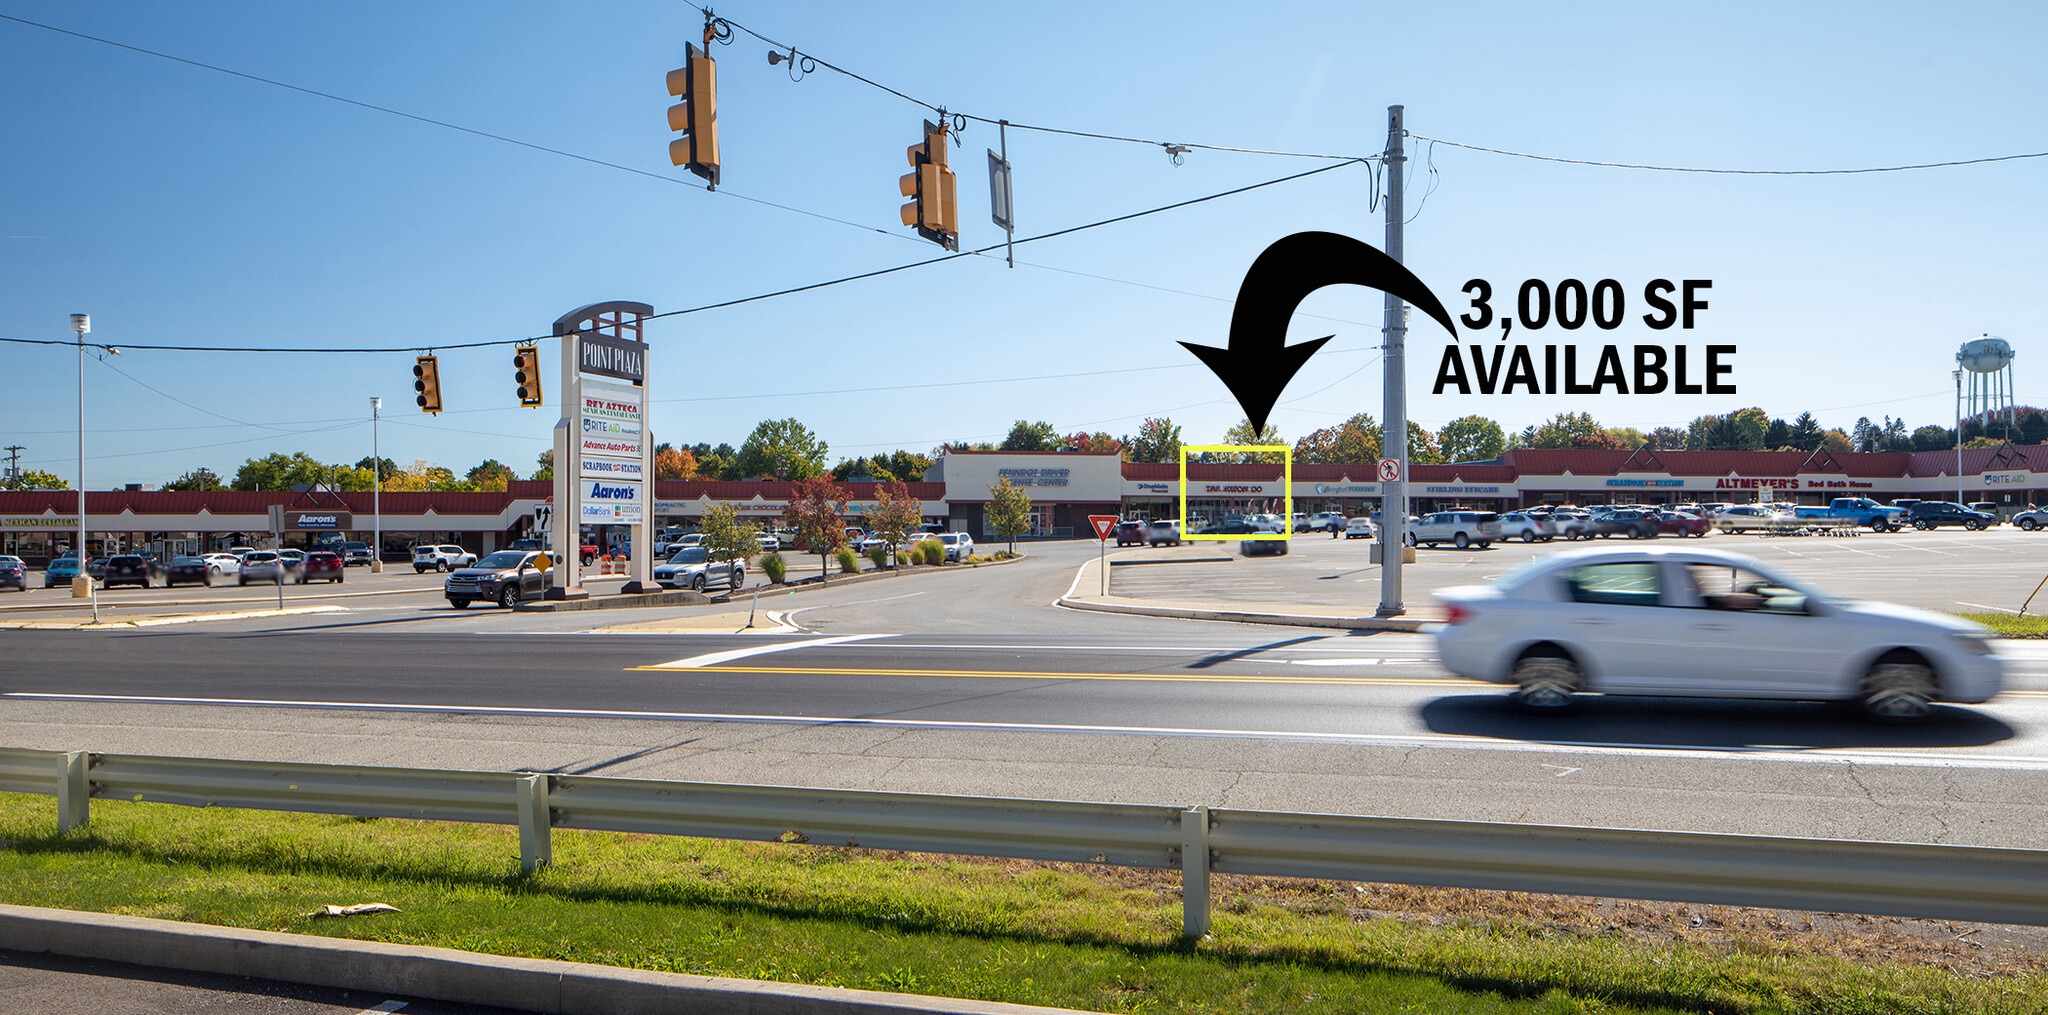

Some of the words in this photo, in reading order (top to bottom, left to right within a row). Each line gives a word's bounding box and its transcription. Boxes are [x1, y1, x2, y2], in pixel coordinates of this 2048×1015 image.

[584, 342, 612, 370] POINT
[615, 349, 641, 375] PLAZA
[586, 399, 604, 409] REY
[606, 403, 637, 413] AZTECA
[592, 420, 607, 432] RITE
[608, 423, 621, 433] AID
[583, 440, 606, 450] Advance
[606, 442, 621, 451] Auto
[621, 443, 636, 453] Parts
[583, 461, 612, 471] SCRAPBOOK
[621, 464, 641, 473] STATION
[998, 468, 1038, 477] PENNDOT
[1041, 468, 1070, 477] DRIVER
[1037, 478, 1069, 487] CENTER
[1716, 478, 1799, 489] ALTMEYER'S
[1993, 475, 2010, 483] RITE
[2012, 475, 2026, 483] AID
[591, 483, 634, 500] Aaron's
[1250, 485, 1262, 493] DO
[622, 506, 640, 514] union
[39, 518, 79, 527] RESTAURAN
[298, 514, 336, 523] Aaron's
